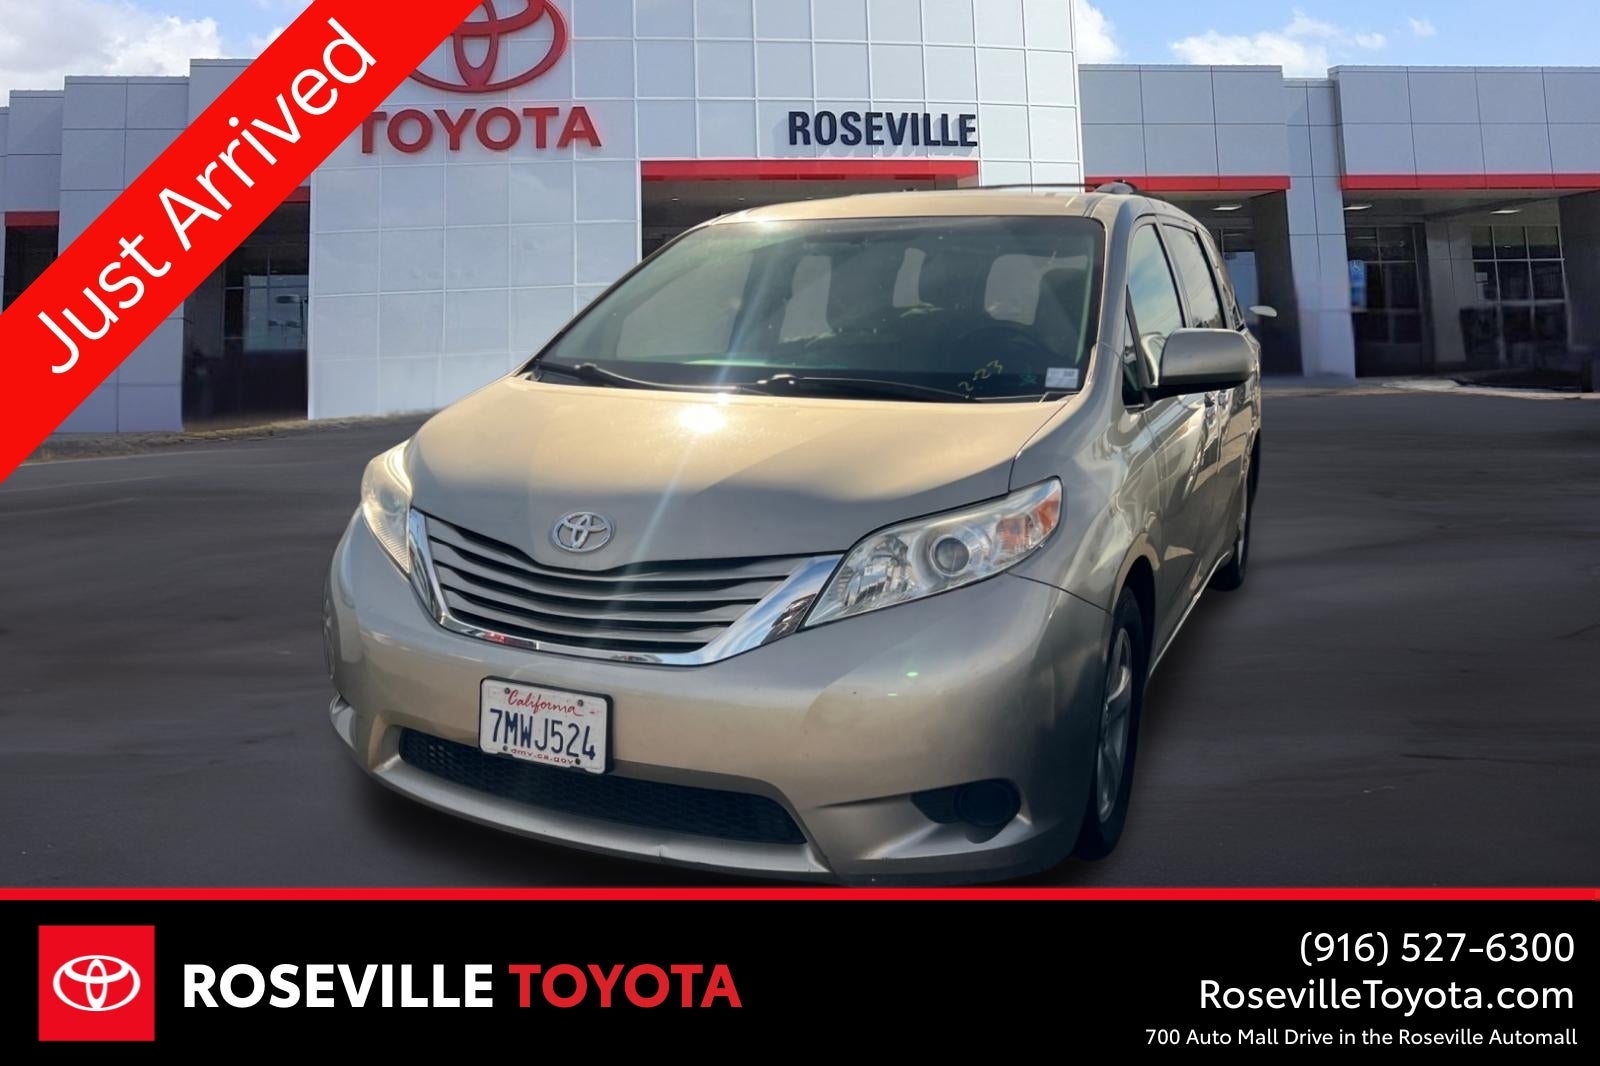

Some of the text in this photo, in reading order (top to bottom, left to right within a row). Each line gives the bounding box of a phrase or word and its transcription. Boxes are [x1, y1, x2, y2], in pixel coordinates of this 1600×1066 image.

[361, 106, 602, 153] TOYOTA
[788, 110, 978, 147] ROSEVILLE
[507, 689, 584, 717] California
[490, 708, 596, 760] 7MWJ524
